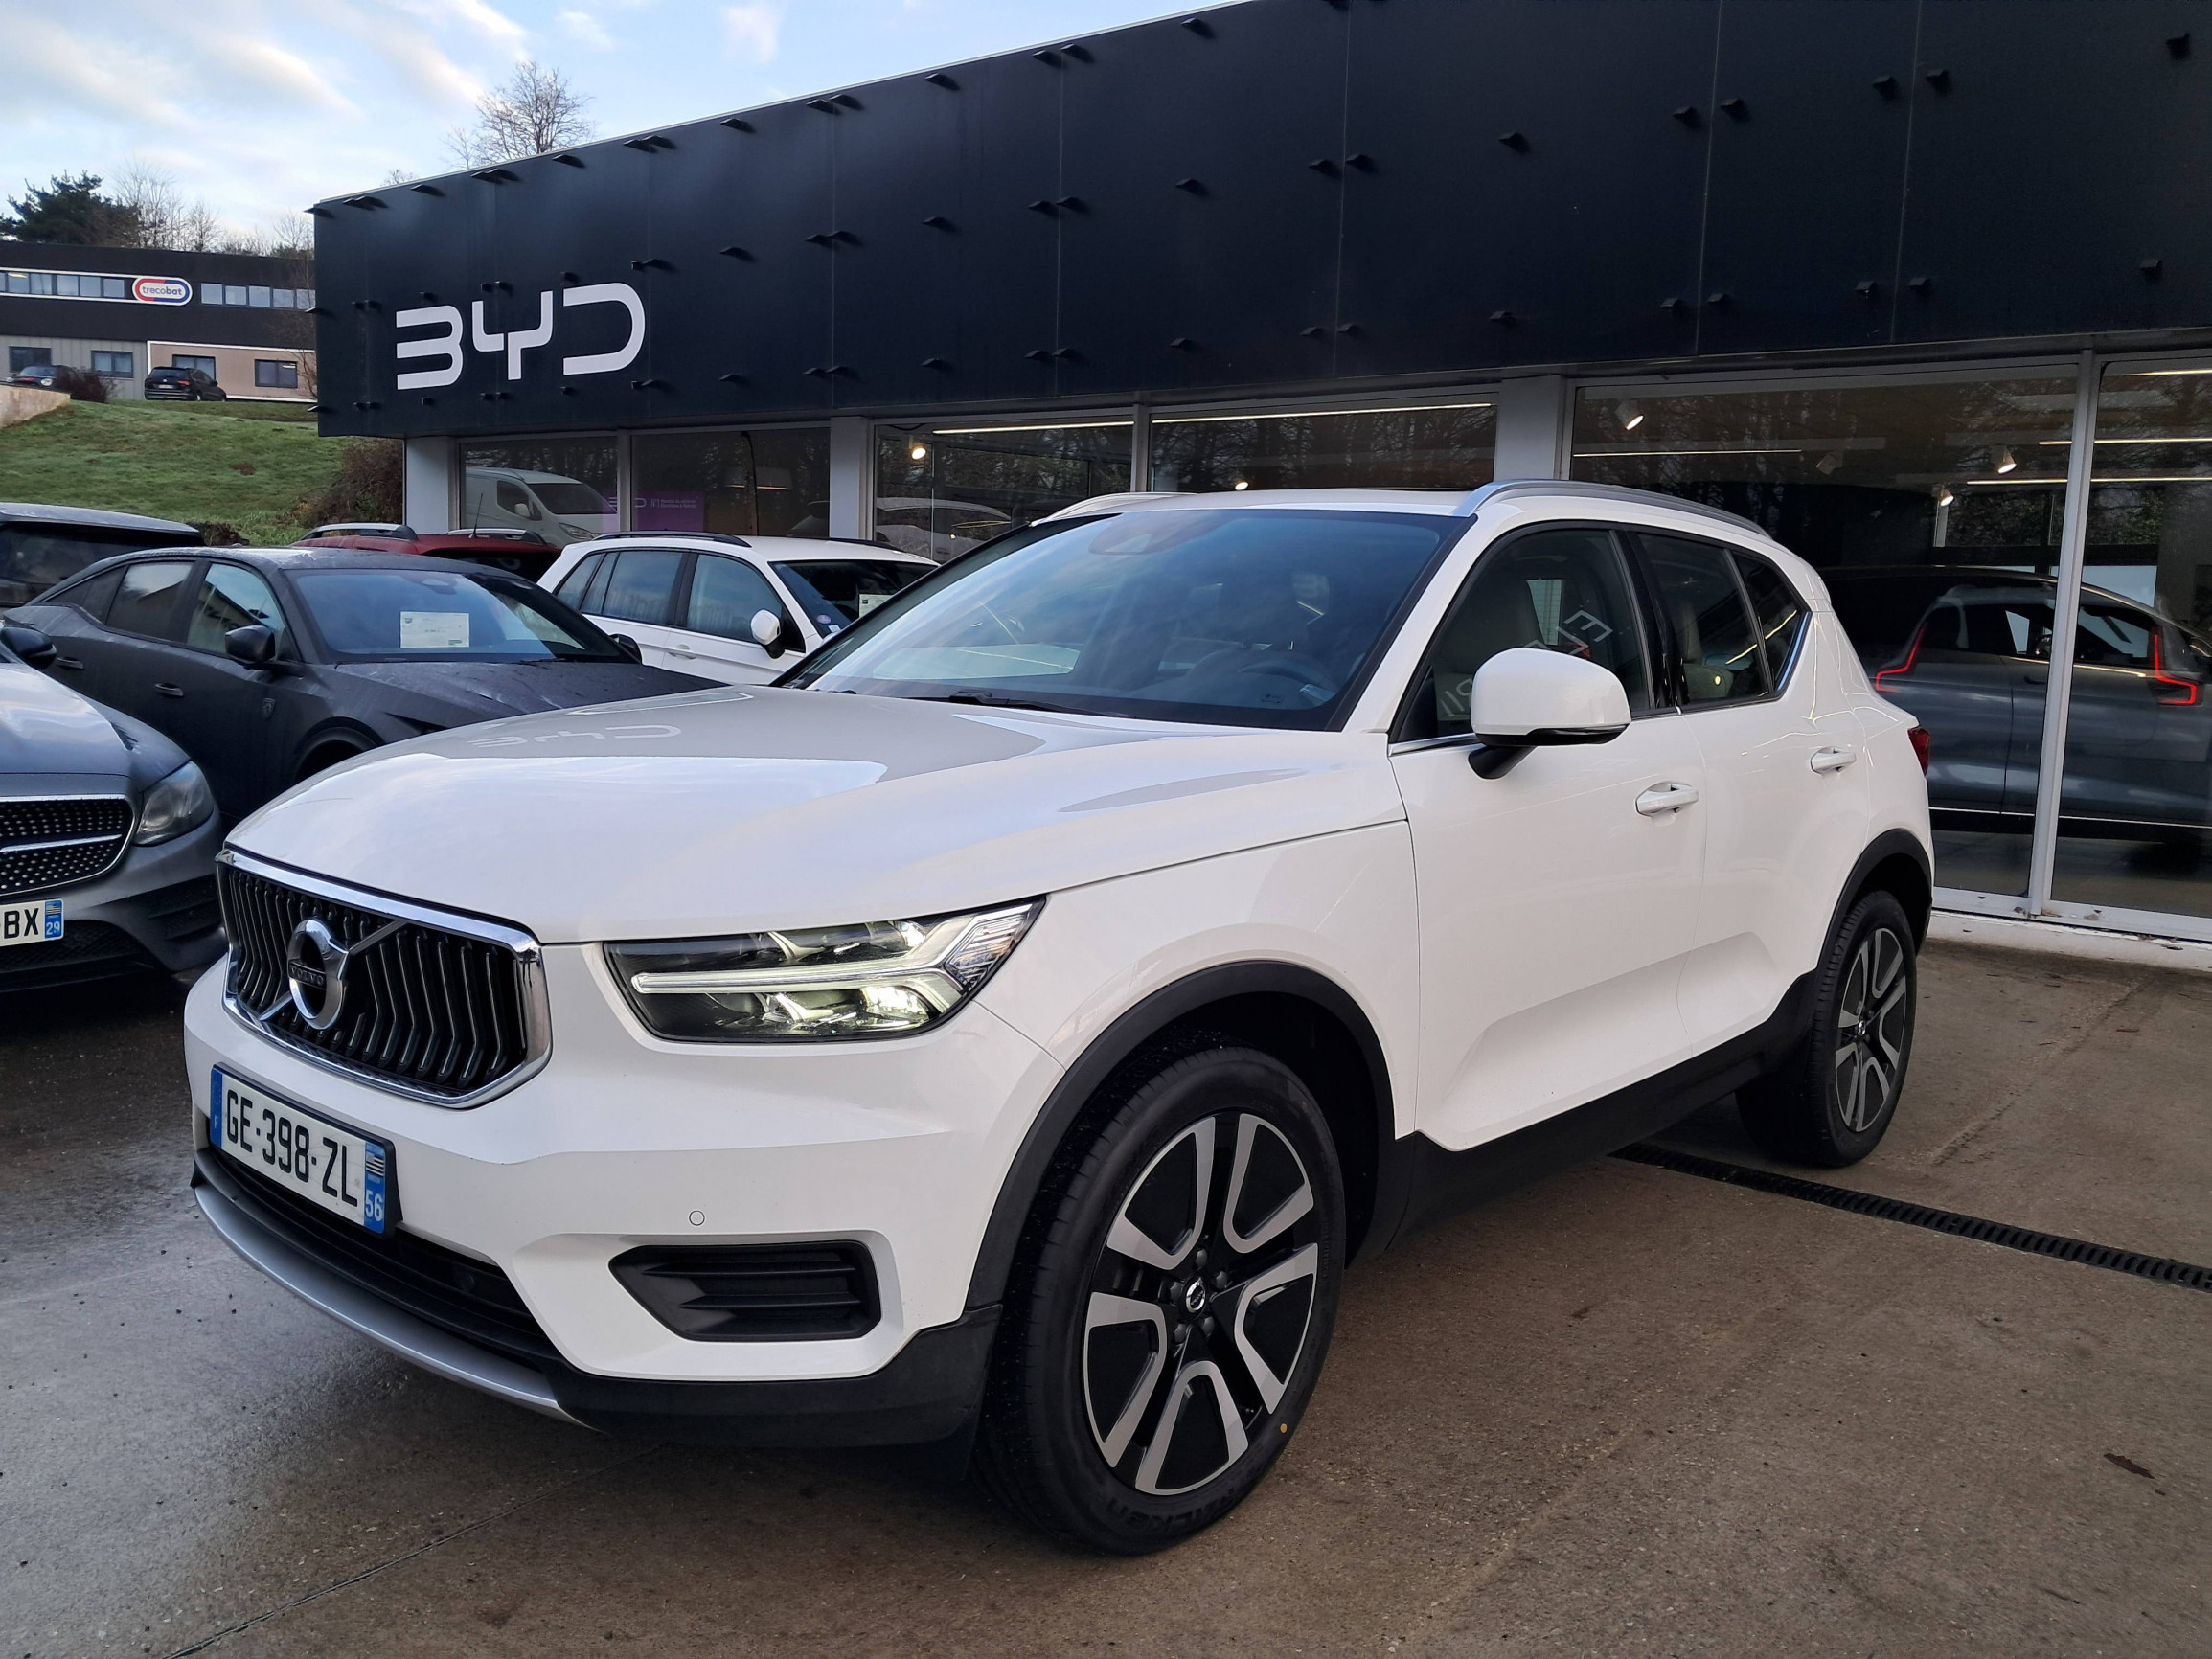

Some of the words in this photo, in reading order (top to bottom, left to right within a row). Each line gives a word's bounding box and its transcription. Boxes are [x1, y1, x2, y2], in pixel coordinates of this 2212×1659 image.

[142, 286, 182, 296] trecobat
[396, 283, 646, 390] BYD
[46, 921, 60, 936] 29
[289, 964, 324, 986] VOLVO
[227, 1089, 358, 1208] GE-398-ZL
[365, 1189, 384, 1222] 56
